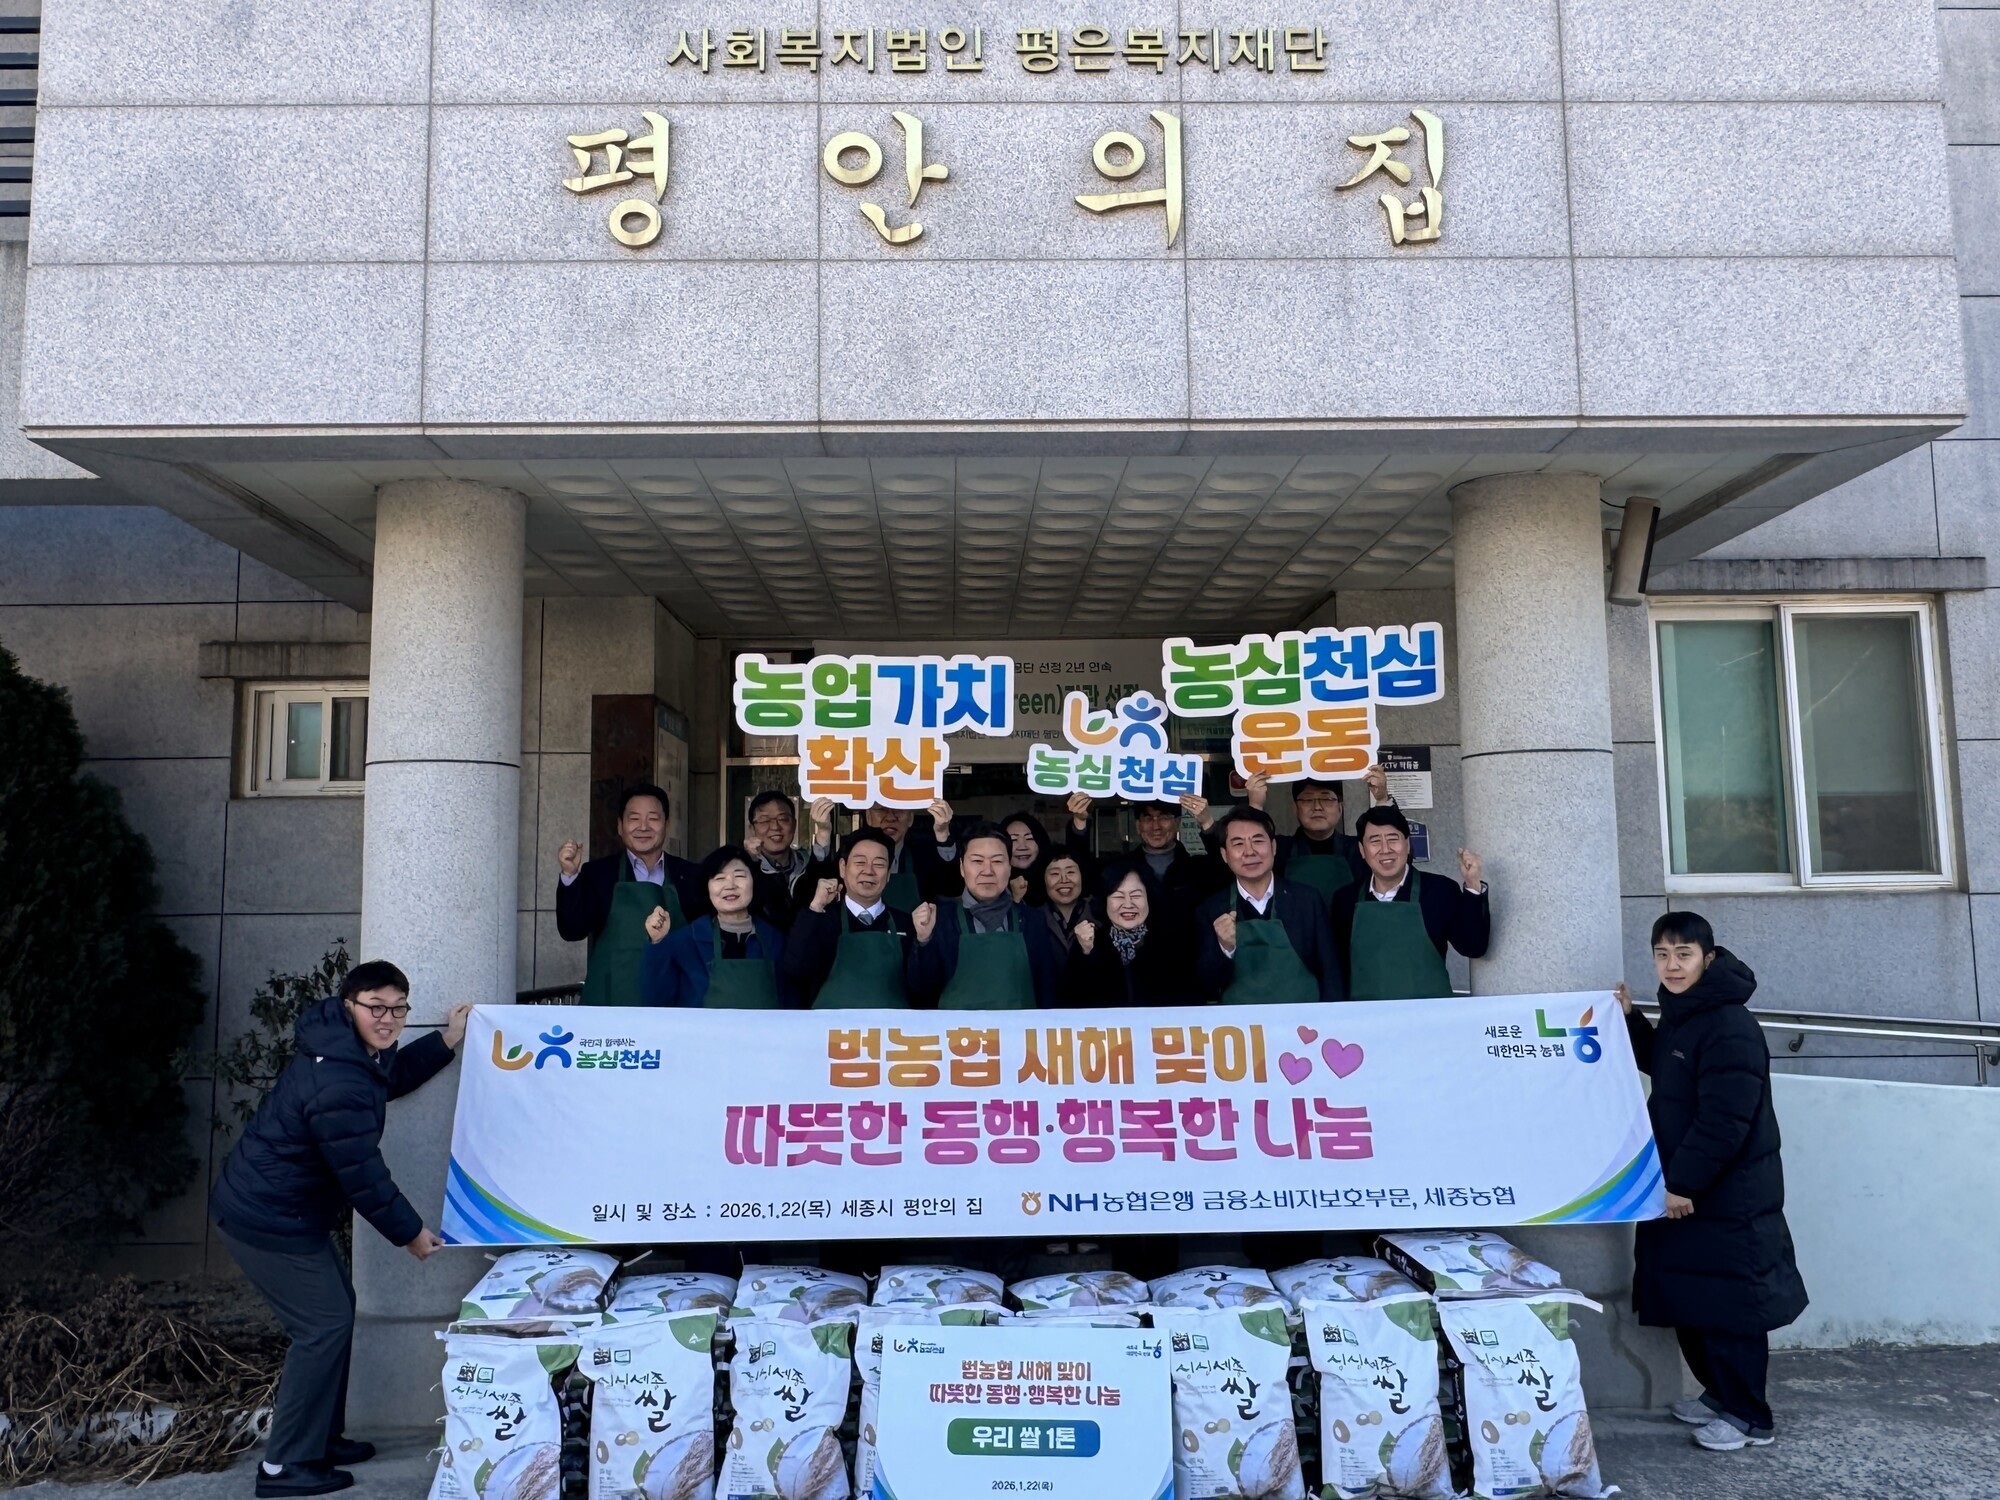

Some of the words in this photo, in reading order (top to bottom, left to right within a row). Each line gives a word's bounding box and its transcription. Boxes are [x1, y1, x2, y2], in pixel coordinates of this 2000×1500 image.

[665, 26, 987, 74] 사회복지법인
[1015, 26, 1331, 74] 평은복지재단
[1038, 661, 1062, 674] 선정
[1065, 661, 1085, 673] 2년
[1088, 660, 1113, 673] 연속
[1170, 629, 1437, 709] 농심천심
[741, 662, 872, 727] 농업
[877, 662, 1006, 728] 가치
[1239, 707, 1372, 775] 운동
[806, 735, 941, 800] 확산
[1033, 750, 1196, 797] 농심천심
[1485, 1025, 1522, 1038] 새로운
[577, 1050, 660, 1069] 농심천심
[828, 1028, 1000, 1087] 범농협
[1018, 1027, 1134, 1085] 새해
[1151, 1025, 1267, 1084] 맞이
[1487, 1045, 1537, 1058] 대한민국
[1540, 1044, 1565, 1057] 농협
[725, 1101, 907, 1167] 따뜻한
[1254, 1098, 1373, 1160] 나눔
[593, 1204, 625, 1222] 일시
[637, 1204, 651, 1221] 및
[662, 1203, 696, 1220] 장소
[720, 1200, 831, 1218] 2026.1.22(목)
[841, 1199, 892, 1217] 세종시
[904, 1198, 955, 1216] 평안의
[967, 1198, 981, 1215] 집
[1049, 1191, 1193, 1212] NH농협은행
[1204, 1189, 1417, 1210] 금융소비자보호부문,
[1424, 1187, 1515, 1206] 세종농협
[962, 1361, 1012, 1380] 범농협
[1017, 1361, 1051, 1380] 새해
[1058, 1362, 1090, 1381] 맞이
[1175, 1356, 1247, 1379] 싱싱세종
[1327, 1353, 1396, 1373] 싱싱세종
[773, 1385, 814, 1423] 쌀
[930, 1384, 982, 1403] 따뜻한
[1086, 1386, 1120, 1406] 나눔
[1220, 1377, 1261, 1421] 쌀
[1373, 1369, 1411, 1414] 쌀
[1517, 1366, 1557, 1412] 쌀
[486, 1405, 527, 1441] 쌀
[634, 1388, 677, 1433] 쌀
[972, 1426, 1013, 1448] 우리
[1020, 1427, 1041, 1448] 쌀
[1047, 1428, 1075, 1449] 1톤
